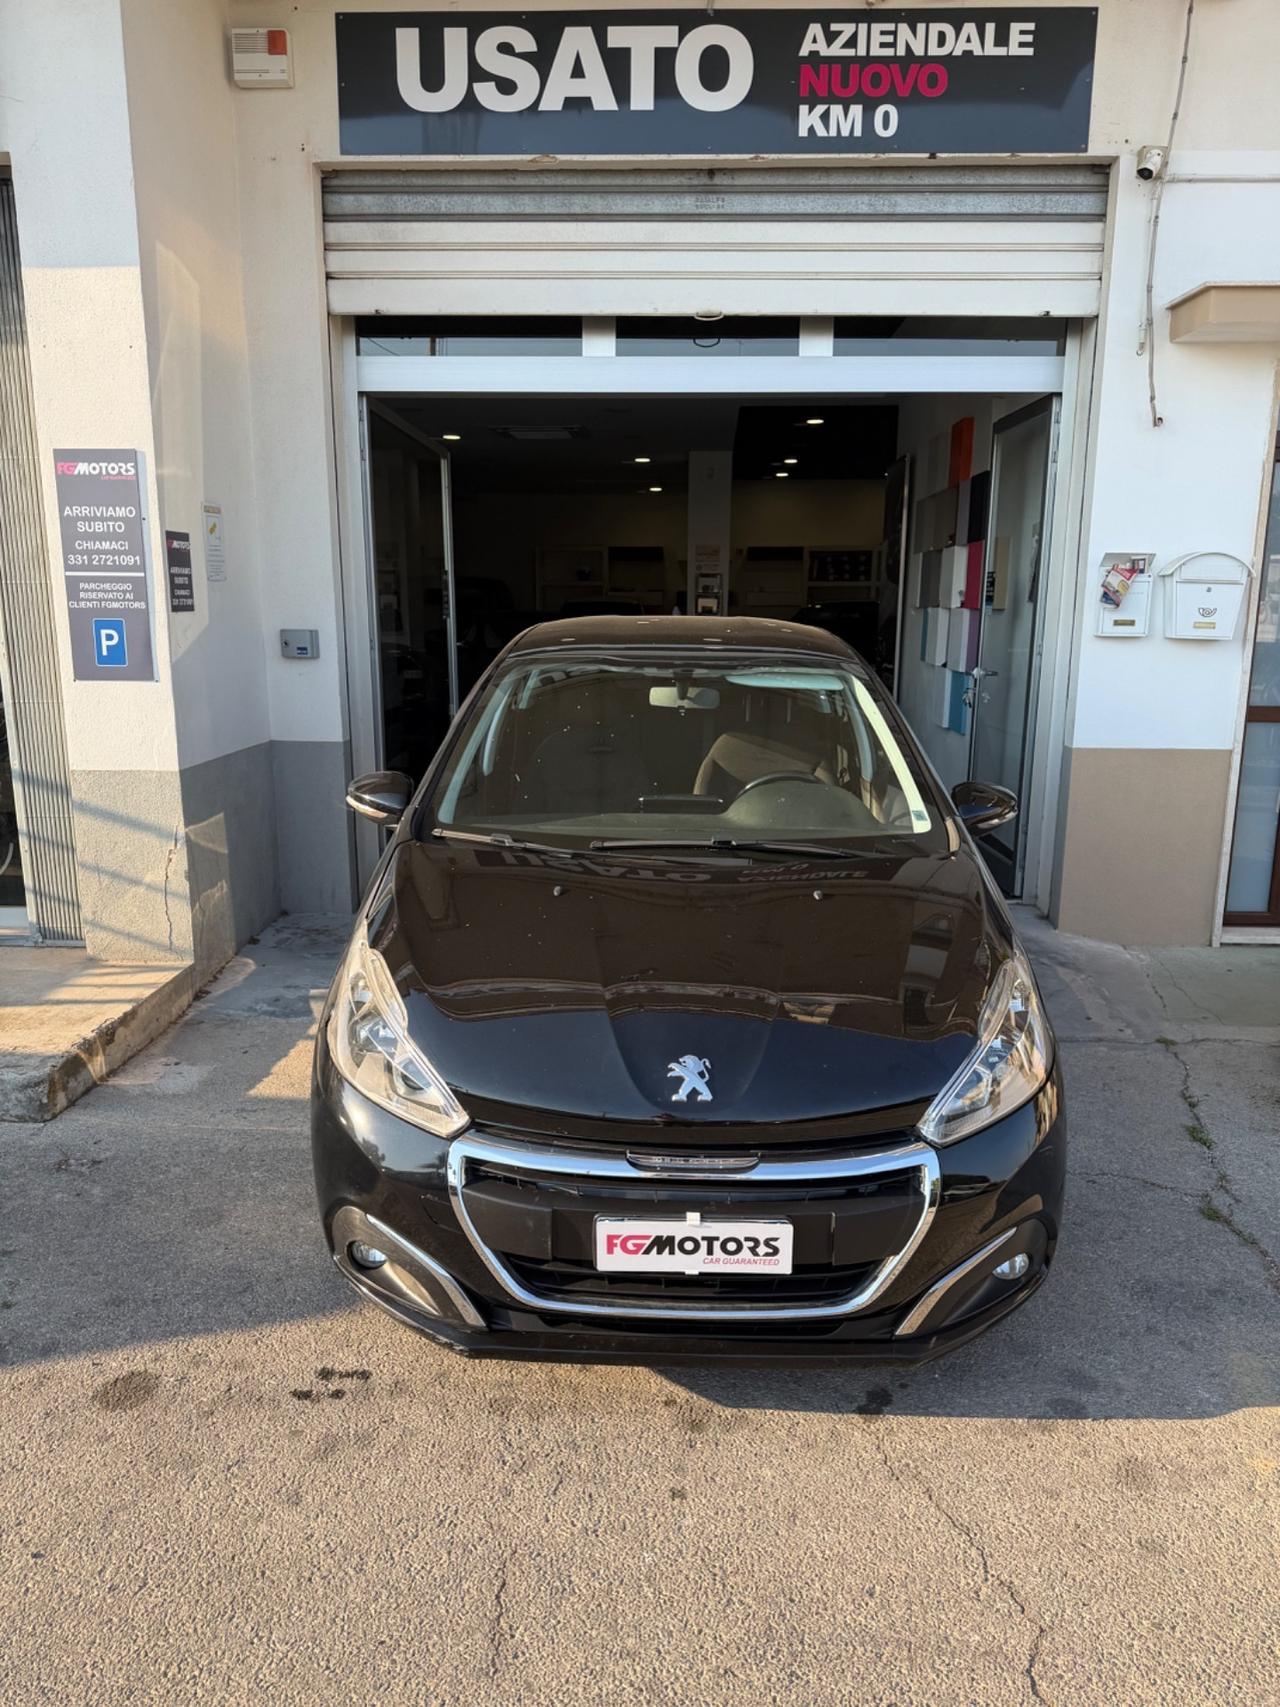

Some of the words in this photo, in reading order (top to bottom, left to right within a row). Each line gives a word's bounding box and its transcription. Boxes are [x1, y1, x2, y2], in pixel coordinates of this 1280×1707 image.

[798, 22, 1036, 57] AZIENDALE
[395, 24, 755, 113] USATO
[799, 63, 949, 97] NUOVO
[798, 104, 864, 137] KM
[874, 103, 899, 138] 0
[56, 462, 135, 475] FGMOTORS
[63, 505, 136, 518] ARRIVIAMO
[76, 520, 125, 532] SUBITO
[75, 540, 129, 551] CHIAMACI
[67, 554, 88, 565] 331
[91, 554, 140, 566] 2721091
[79, 582, 133, 591] PARCHEGGIO
[79, 591, 124, 600] RISERVATO
[125, 592, 134, 600] AI
[68, 601, 100, 609] CLIENTI
[101, 601, 147, 609] FGMOTORS
[100, 629, 120, 656] P
[606, 1234, 781, 1257] FGMOTORS
[702, 1257, 722, 1265] CAR
[722, 1257, 781, 1266] GUARANTEED
